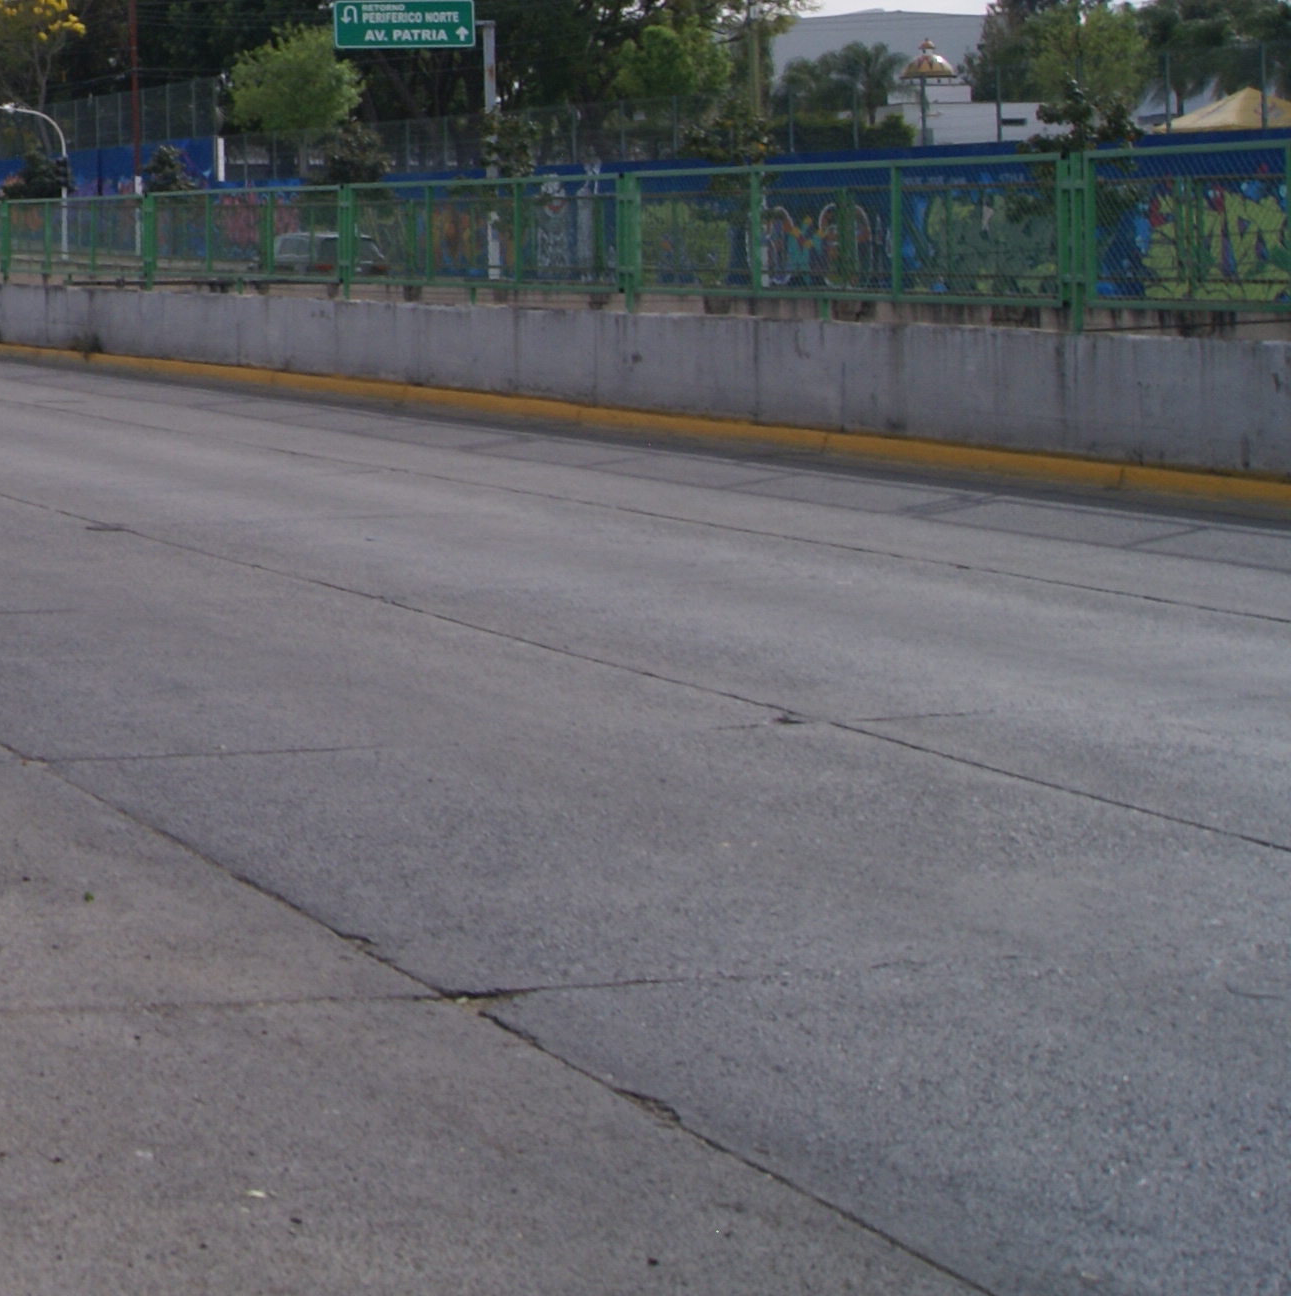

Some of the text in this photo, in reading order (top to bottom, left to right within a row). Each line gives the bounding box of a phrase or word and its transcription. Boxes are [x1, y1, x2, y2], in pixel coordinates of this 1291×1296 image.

[362, 12, 459, 23] PERIFERICO NORTE
[364, 29, 448, 41] AV. PATRIA
